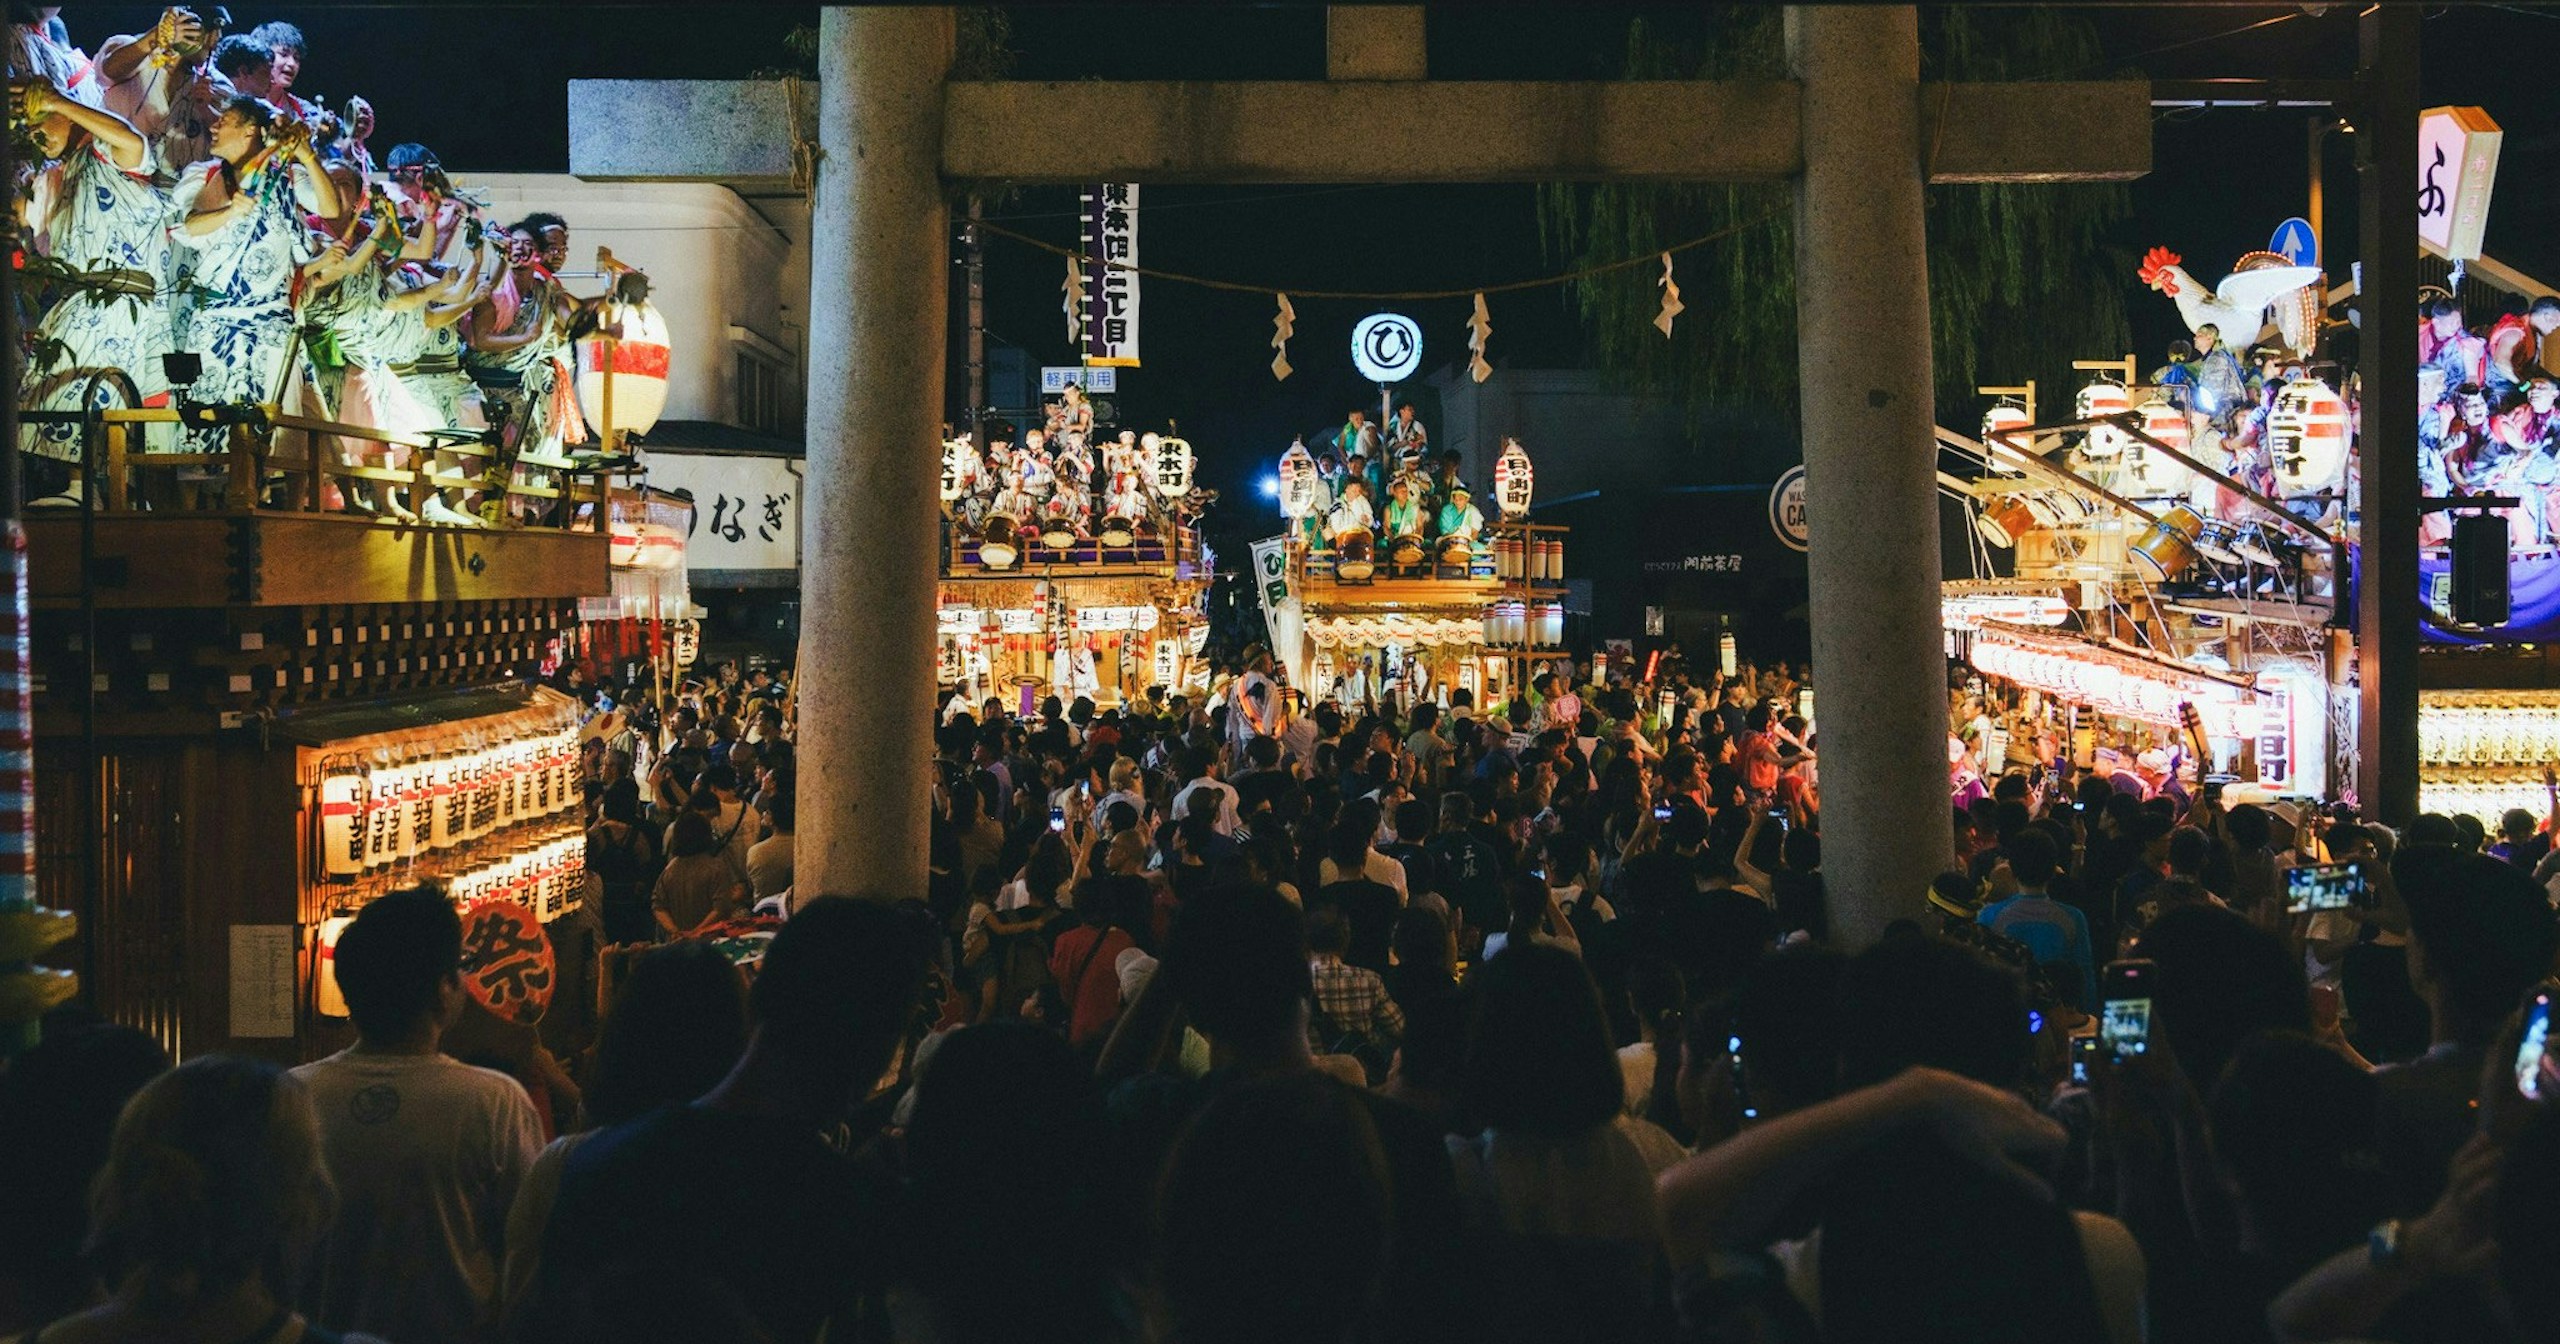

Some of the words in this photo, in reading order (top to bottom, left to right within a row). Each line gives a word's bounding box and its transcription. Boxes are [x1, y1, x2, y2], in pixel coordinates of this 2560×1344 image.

[1373, 326, 1410, 363] ひ
[1158, 441, 1184, 488] 東本町
[688, 493, 791, 543] なぎ
[461, 913, 550, 1006] 祭
